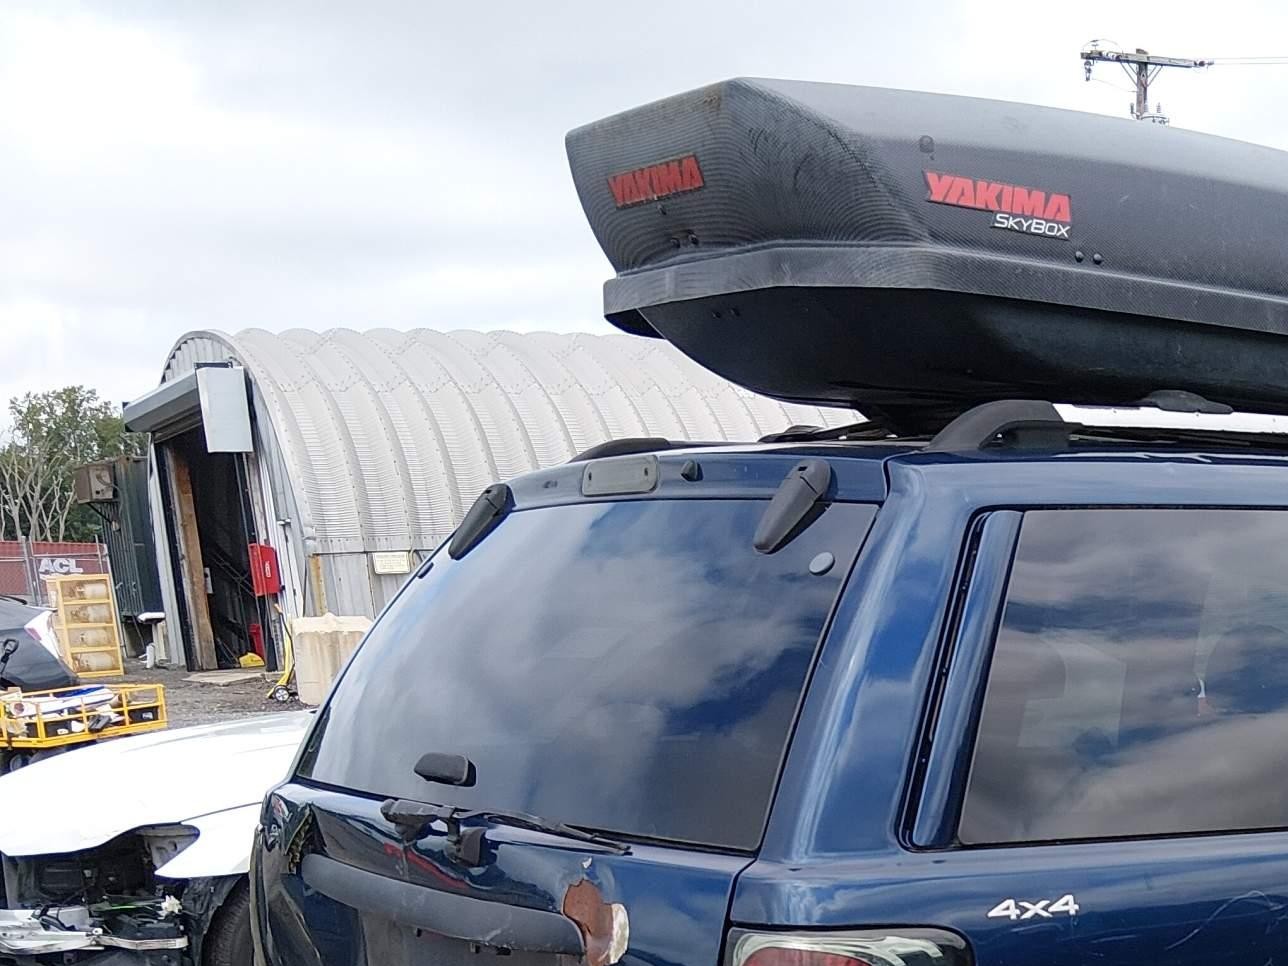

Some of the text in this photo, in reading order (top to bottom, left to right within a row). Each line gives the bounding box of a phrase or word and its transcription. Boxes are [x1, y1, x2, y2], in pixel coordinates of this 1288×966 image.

[607, 154, 704, 207] YAKIMA
[925, 171, 1072, 222] YAKIMA
[38, 558, 83, 573] ACL
